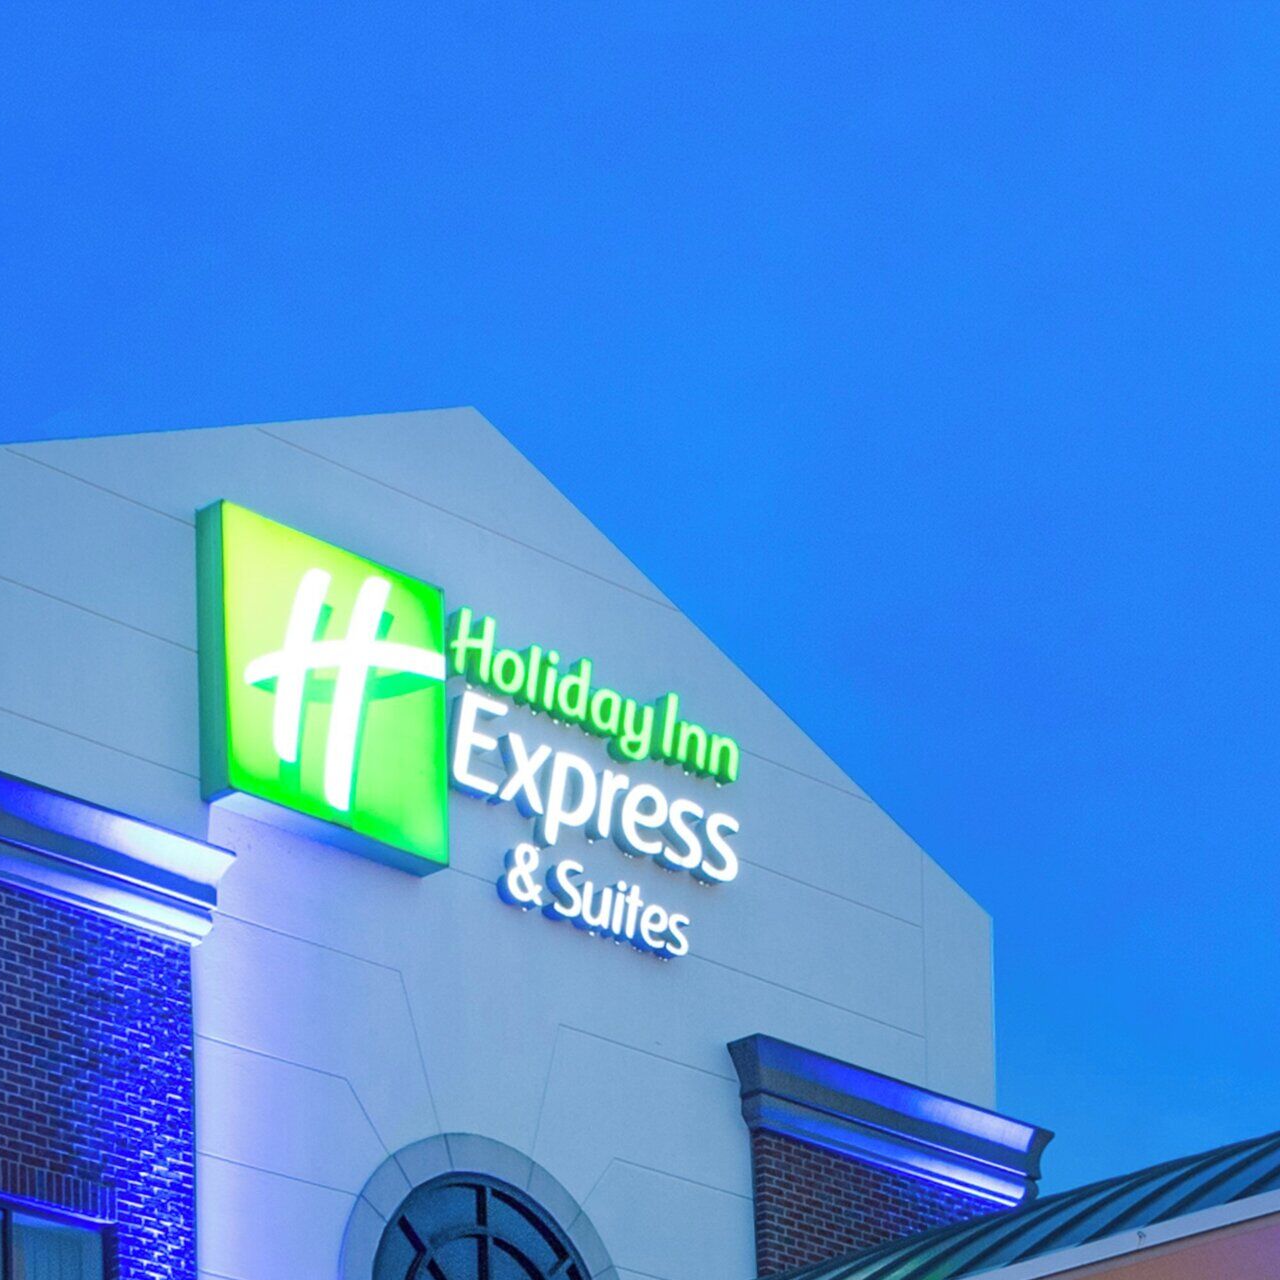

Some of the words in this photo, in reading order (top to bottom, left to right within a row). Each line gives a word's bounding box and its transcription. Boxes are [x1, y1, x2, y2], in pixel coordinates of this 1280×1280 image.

[450, 606, 655, 761] Holiday
[661, 691, 740, 783] Inn
[452, 690, 740, 882] Express
[507, 842, 543, 906] &
[553, 859, 690, 957] Suites
